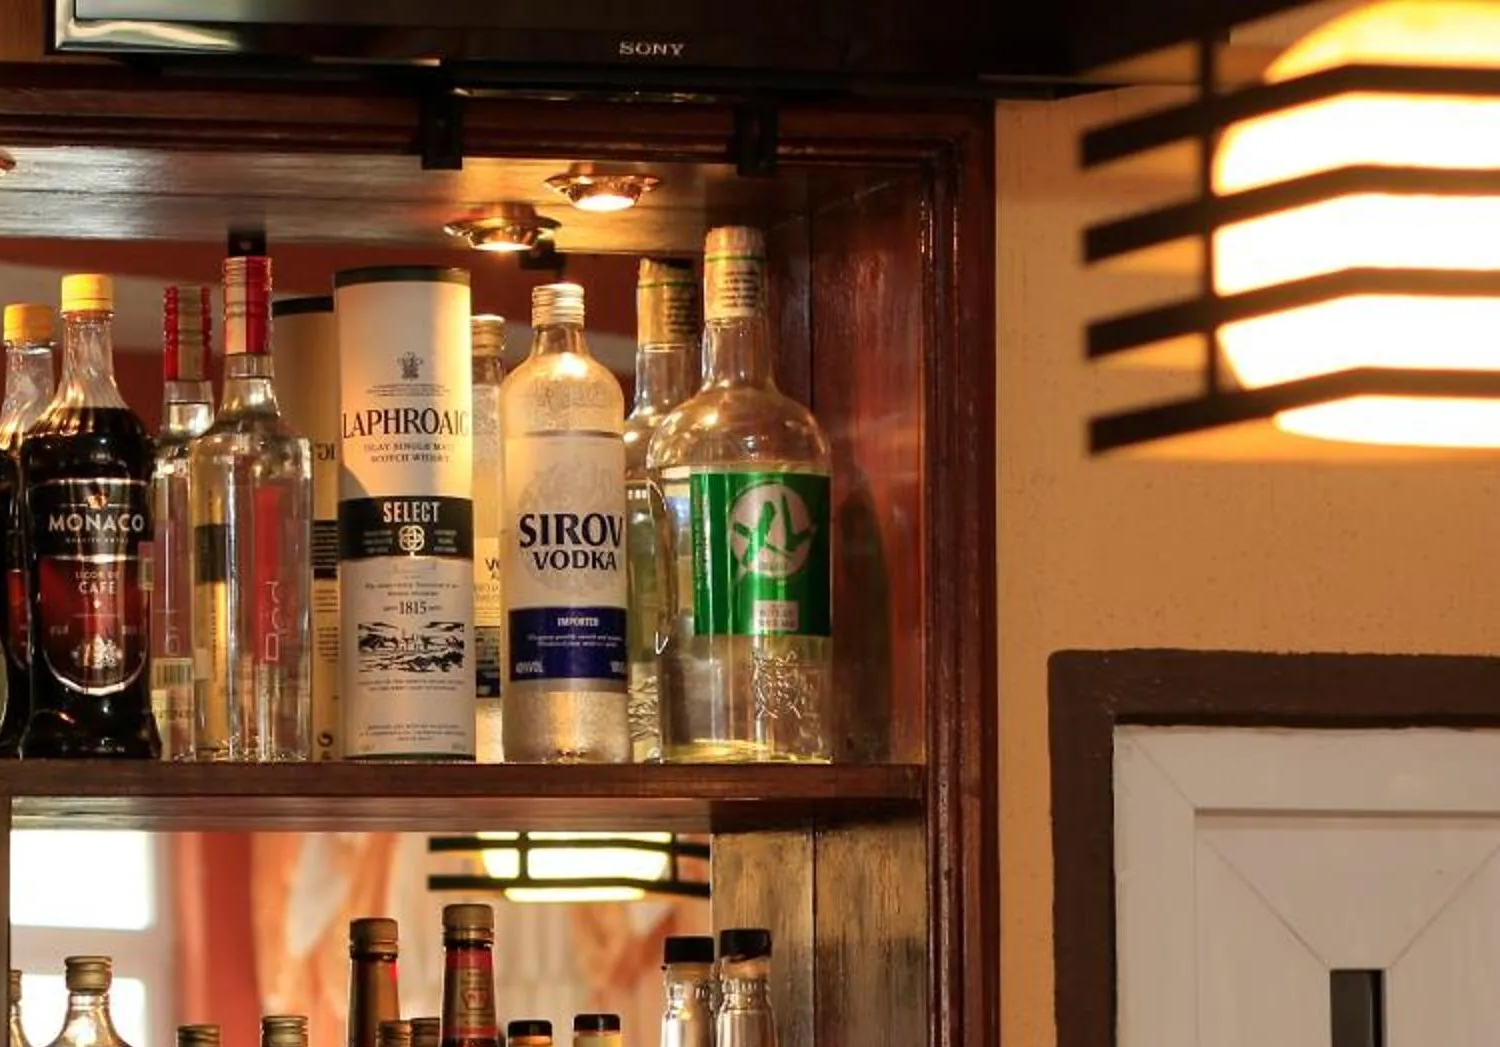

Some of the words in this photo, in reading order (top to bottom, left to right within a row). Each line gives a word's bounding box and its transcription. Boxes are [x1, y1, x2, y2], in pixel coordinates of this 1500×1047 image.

[618, 41, 685, 57] SONY
[343, 407, 470, 439] LAPHROAIG
[48, 512, 145, 532] MONACO
[383, 501, 441, 523] SELECT
[519, 513, 623, 548] SIROV
[533, 550, 617, 570] VODKA
[399, 601, 427, 614] 1815
